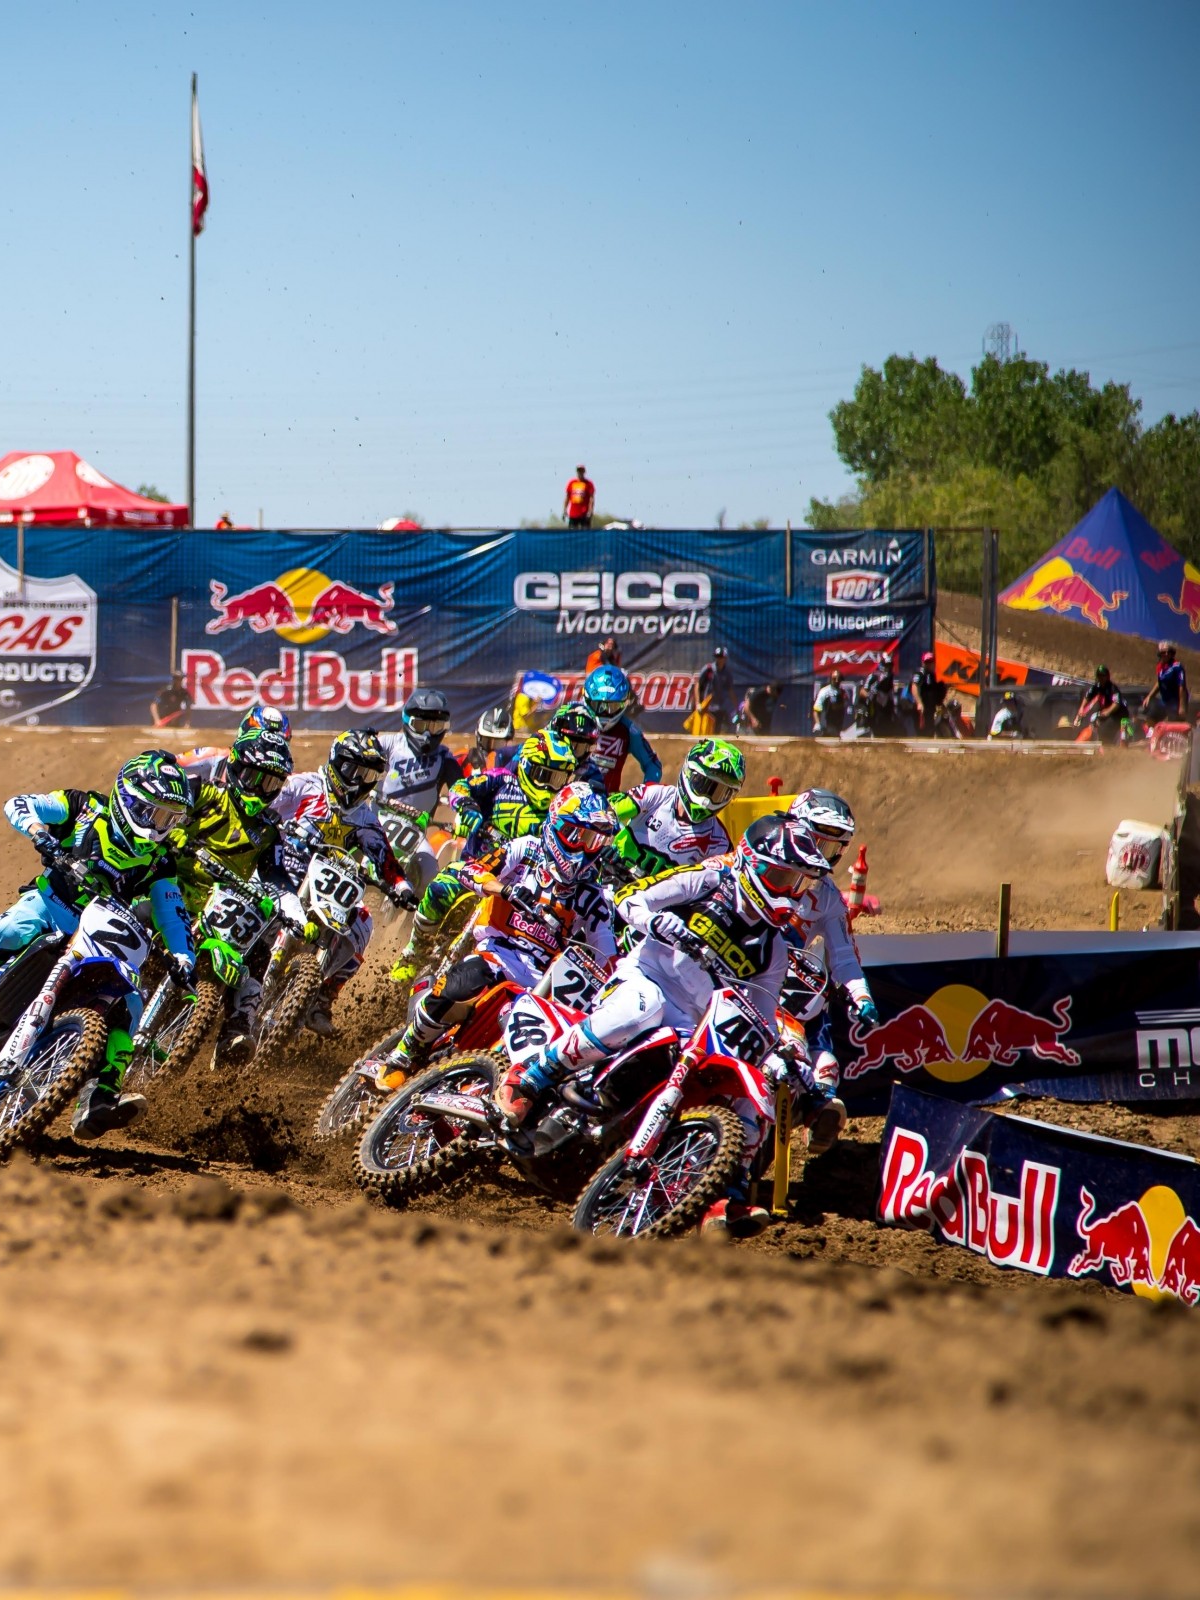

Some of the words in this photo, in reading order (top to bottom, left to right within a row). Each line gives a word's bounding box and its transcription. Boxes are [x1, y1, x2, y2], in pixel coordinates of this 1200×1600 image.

[810, 547, 902, 566] GARMIN
[1064, 537, 1121, 570] Bull
[514, 572, 712, 610] GEICO
[835, 579, 883, 600] 100%
[556, 610, 711, 639] Motorcycle
[827, 613, 904, 634] Husqvarna
[183, 648, 298, 711] Red
[302, 648, 419, 711] Bull
[314, 868, 359, 909] 30
[738, 872, 765, 909] GEICO
[114, 907, 134, 926] LUCAS
[208, 897, 263, 948] 33
[508, 911, 537, 938] Red
[534, 922, 561, 950] Bull
[88, 918, 142, 963] 2
[687, 911, 756, 979] GEICO
[803, 975, 818, 989] OIL
[740, 1003, 758, 1022] LUCAS
[7, 1013, 29, 1060] DUNLOP
[507, 1009, 550, 1056] 48
[715, 1014, 765, 1066] 48
[638, 1105, 664, 1150] DUNLOP
[877, 1127, 968, 1243] Red
[964, 1144, 1062, 1275] Bull
